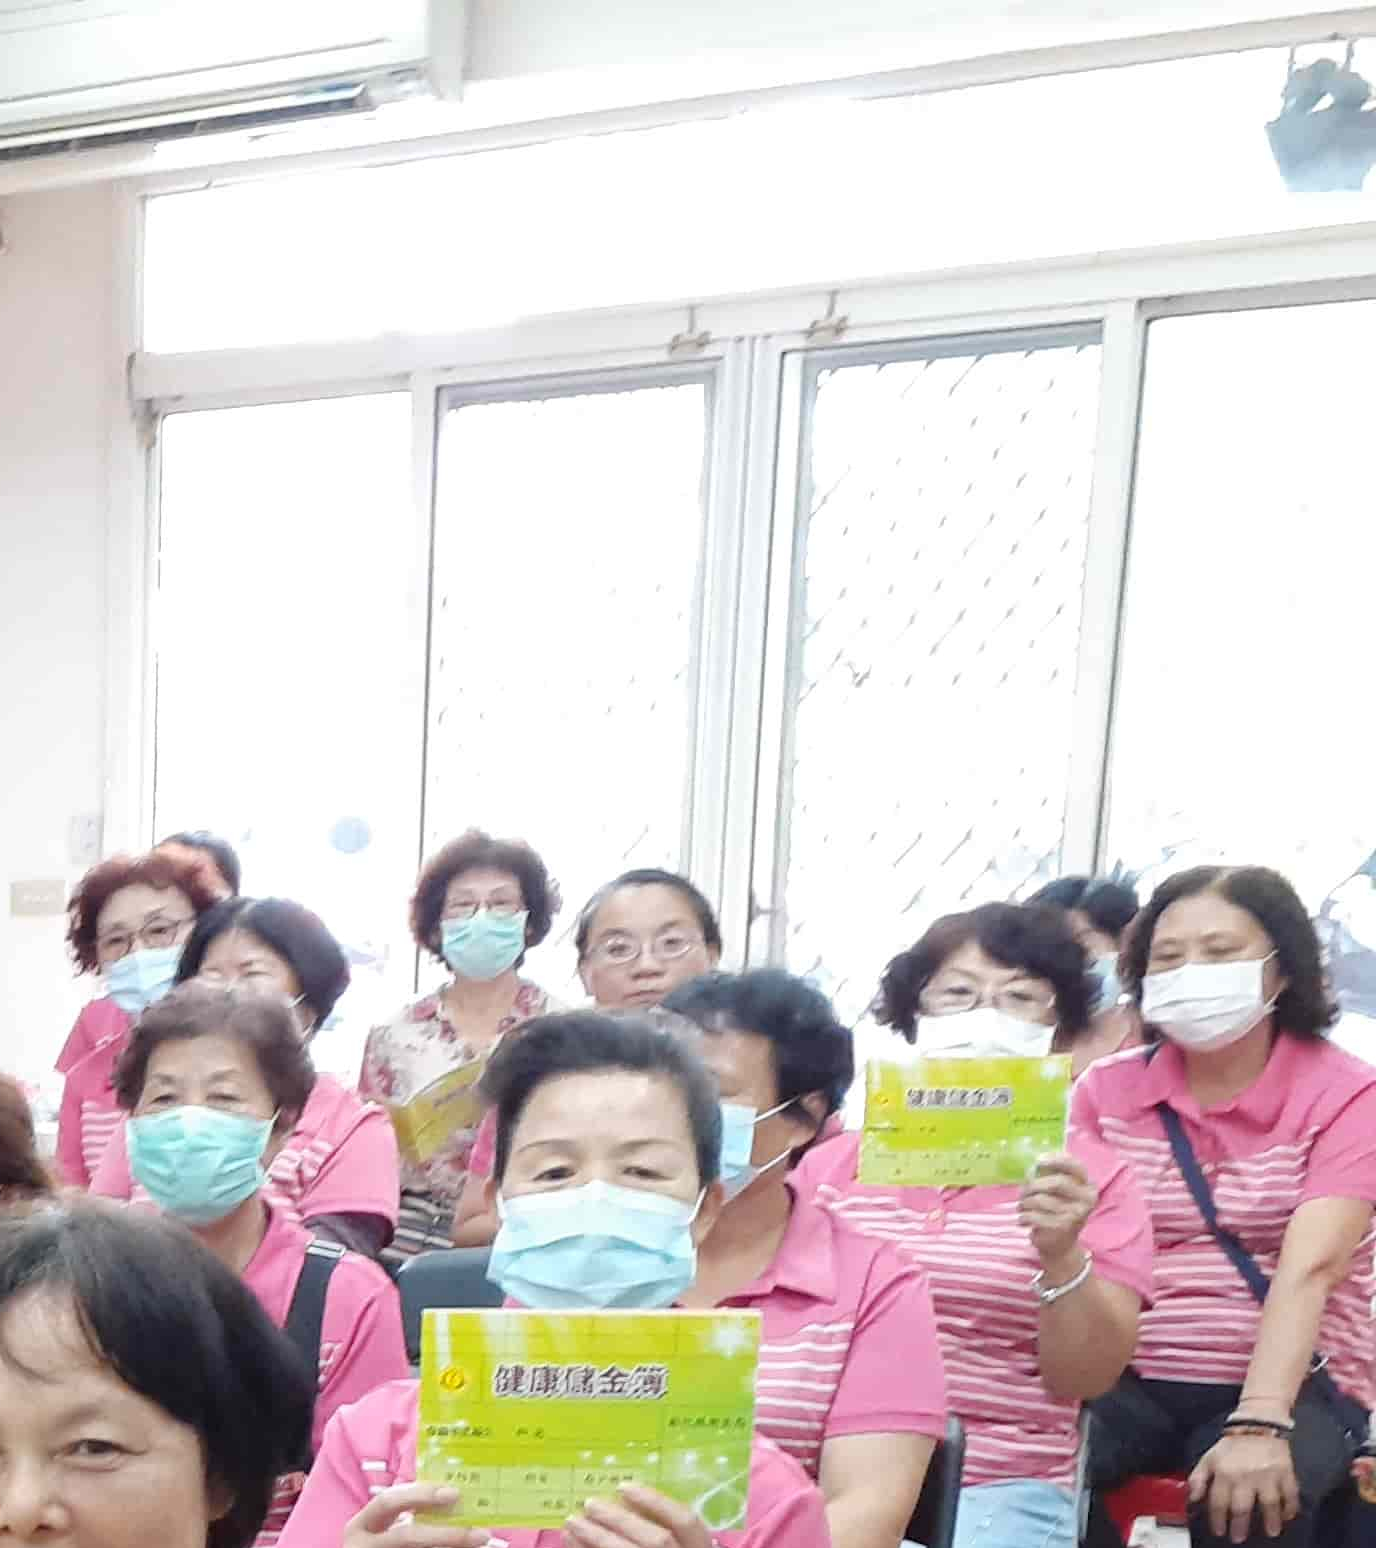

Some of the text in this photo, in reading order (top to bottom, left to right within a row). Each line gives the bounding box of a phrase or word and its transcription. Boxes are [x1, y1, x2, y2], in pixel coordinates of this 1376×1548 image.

[494, 1363, 668, 1399] 健康儲金簿
